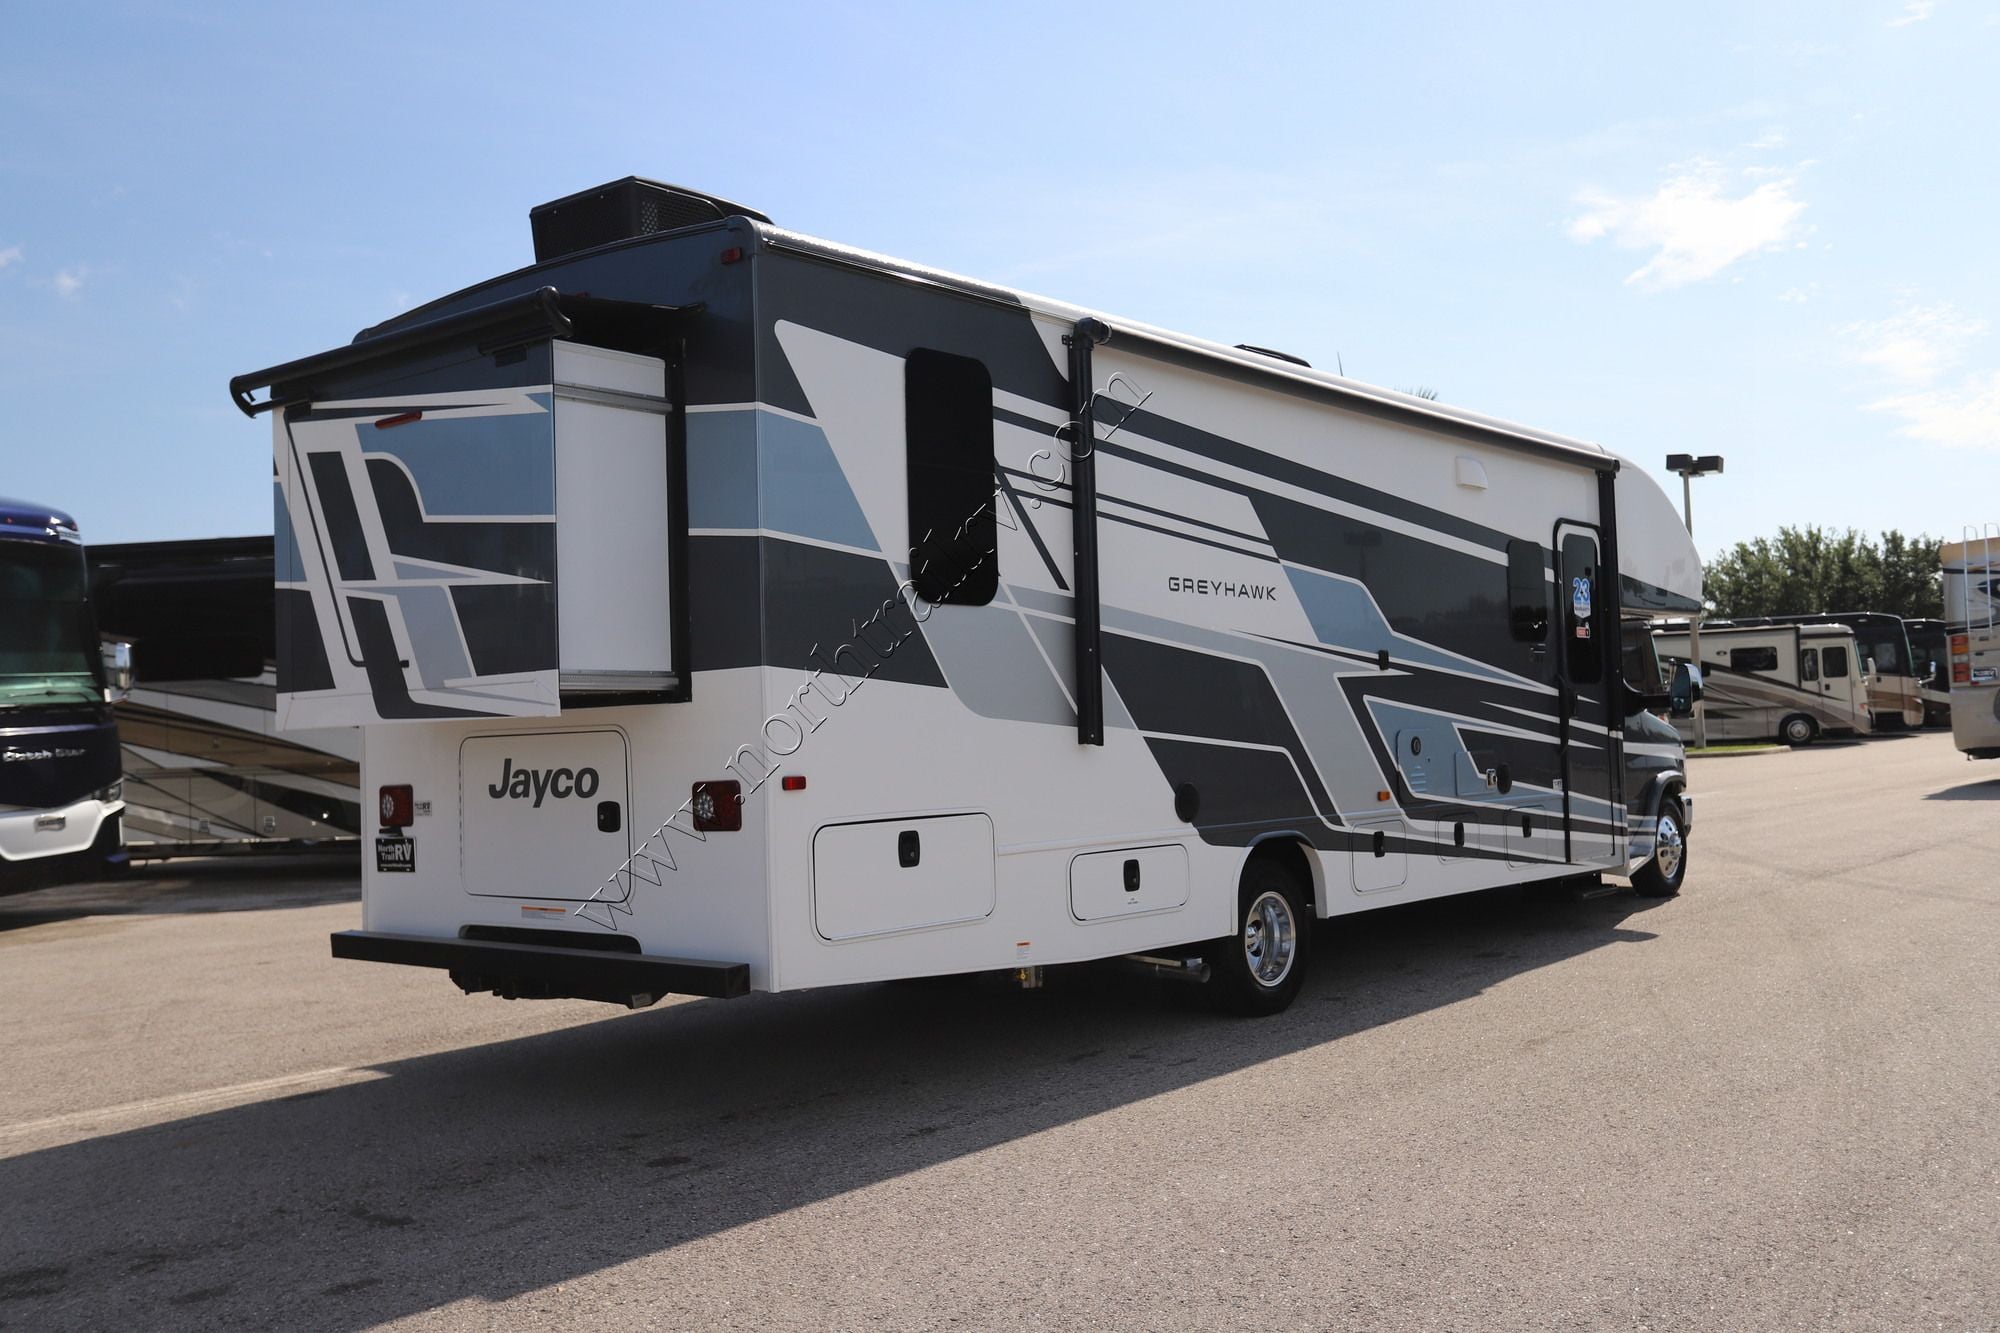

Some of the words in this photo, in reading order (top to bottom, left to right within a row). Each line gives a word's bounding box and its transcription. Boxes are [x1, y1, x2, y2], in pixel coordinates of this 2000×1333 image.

[1168, 576, 1277, 601] GREYHAWK
[488, 758, 600, 808] Jayco
[395, 844, 412, 861] RV
